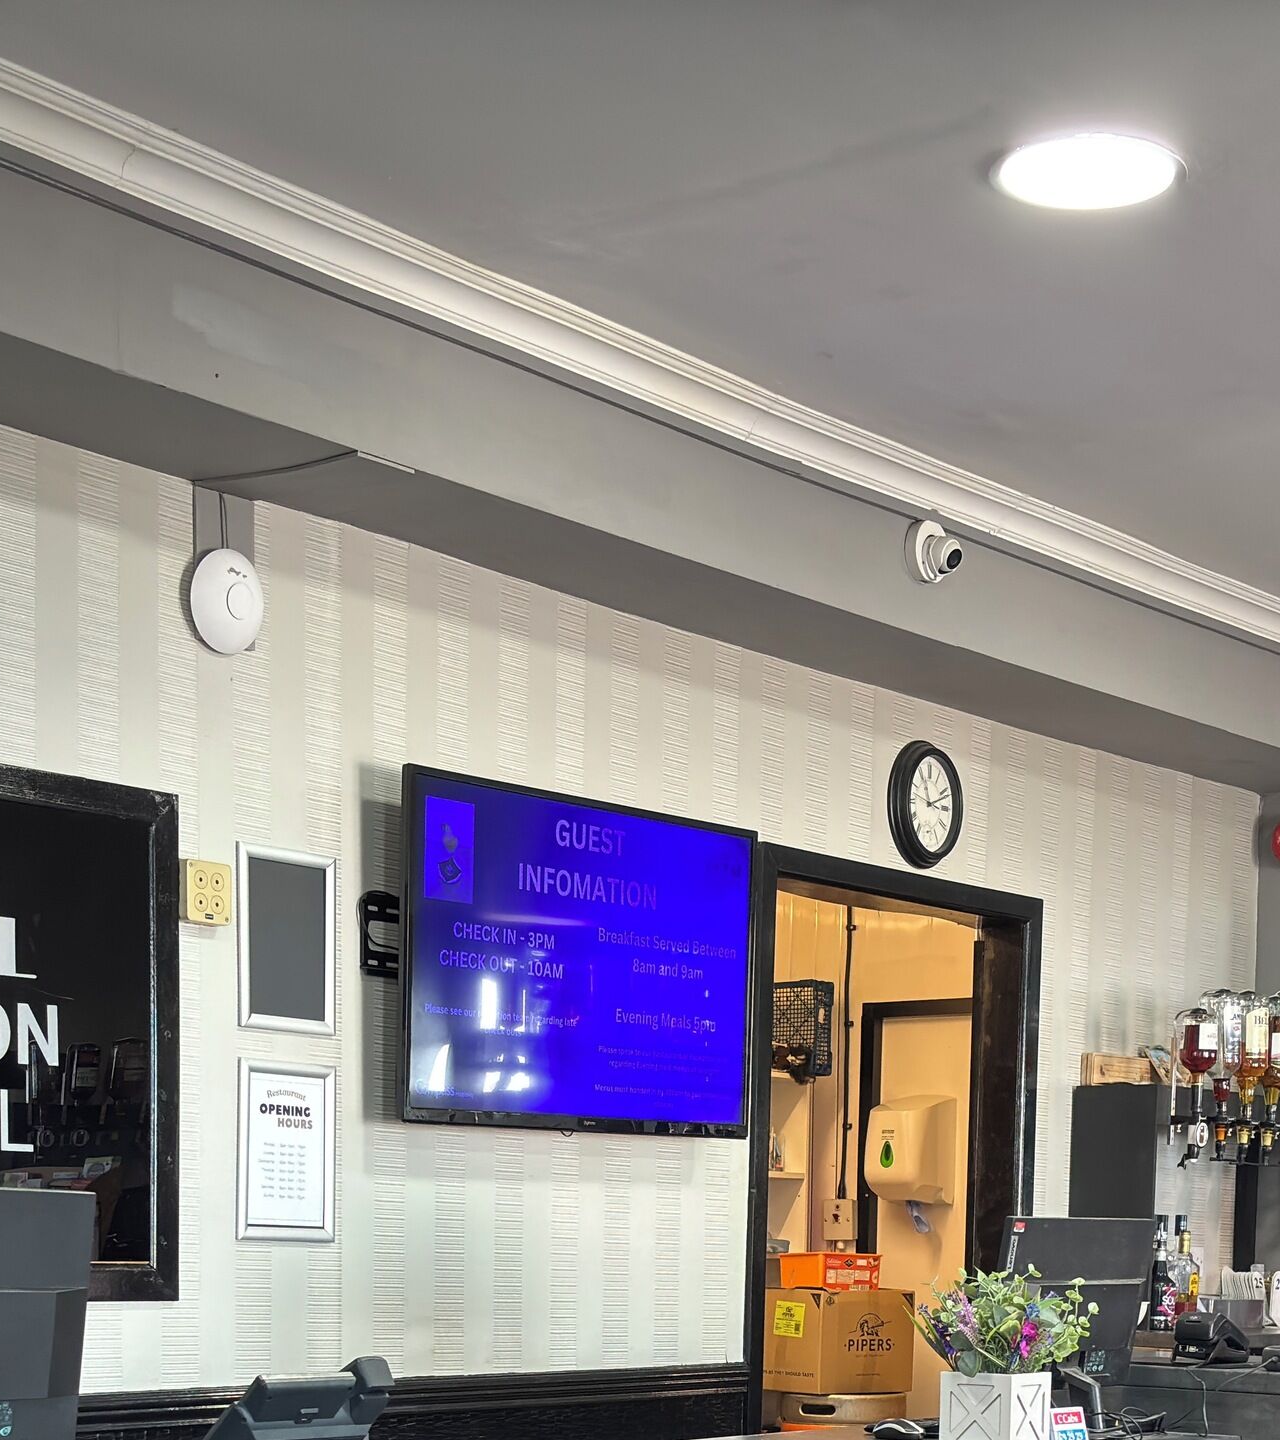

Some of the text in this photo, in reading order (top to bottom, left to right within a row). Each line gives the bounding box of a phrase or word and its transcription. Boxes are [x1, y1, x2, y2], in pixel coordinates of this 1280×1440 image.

[555, 819, 626, 856] GUEST
[518, 862, 657, 910] INFOMATION
[453, 921, 500, 944] CHECK
[503, 929, 517, 945] IN
[527, 931, 555, 950] 3PM
[598, 927, 737, 959] Breakfast Served Between
[439, 949, 486, 972] CHECK
[489, 955, 518, 974] OUT
[527, 961, 564, 979] 10AM
[632, 958, 704, 980] 8am and 9am
[424, 1003, 449, 1016] Please
[450, 1007, 463, 1016] see
[615, 1007, 659, 1030] Evening
[661, 1012, 691, 1030] Meals
[266, 1089, 307, 1102] Restaurant
[259, 1103, 311, 1117] OPENING
[277, 1117, 313, 1130] HOURS
[1253, 1277, 1263, 1288] 25
[847, 1338, 892, 1352] PIPERS
